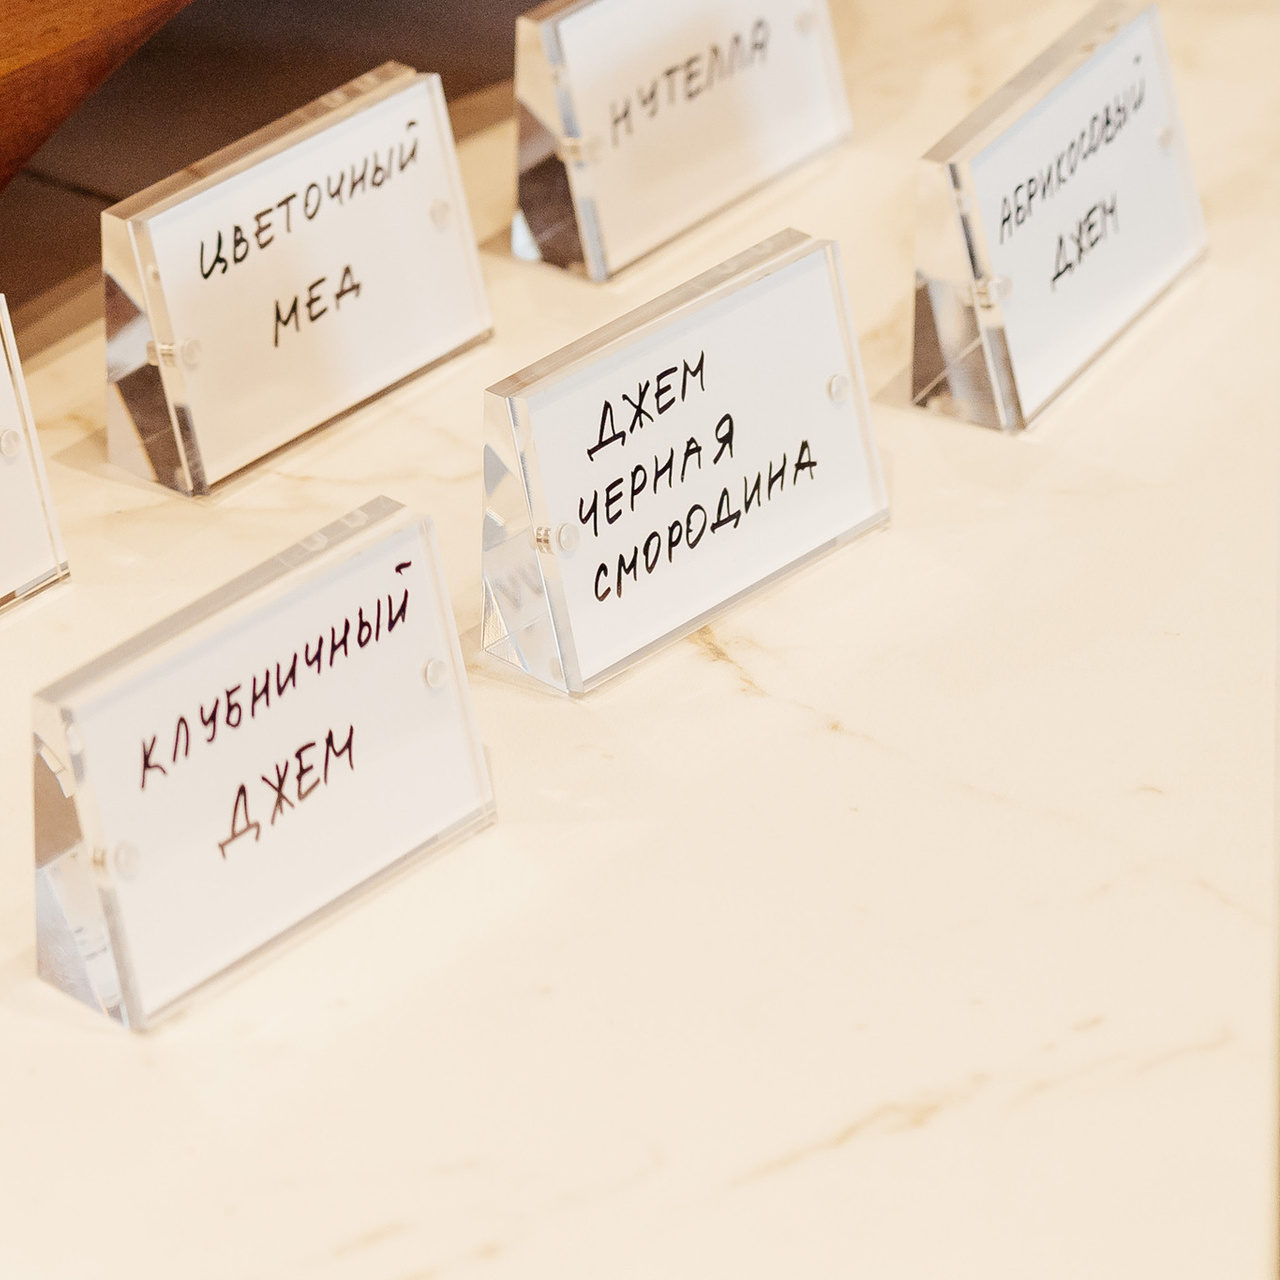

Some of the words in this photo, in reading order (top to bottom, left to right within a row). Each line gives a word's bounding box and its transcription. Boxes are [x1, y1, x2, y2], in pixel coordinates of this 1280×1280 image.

[609, 18, 770, 144] НУТЕЛЛА
[198, 121, 420, 282] ЦВЕТОЧНЫЙ
[1050, 191, 1120, 292] ДЖЕМ
[272, 264, 363, 349] МЕД
[586, 349, 707, 463] ДЖЕМ
[577, 411, 735, 538] ЧЕРНАЯ
[592, 438, 819, 603] СМОРОДИНА
[139, 560, 413, 791] КЛУБНИЧНЫЙ
[217, 724, 356, 859] ДЖЕМ
